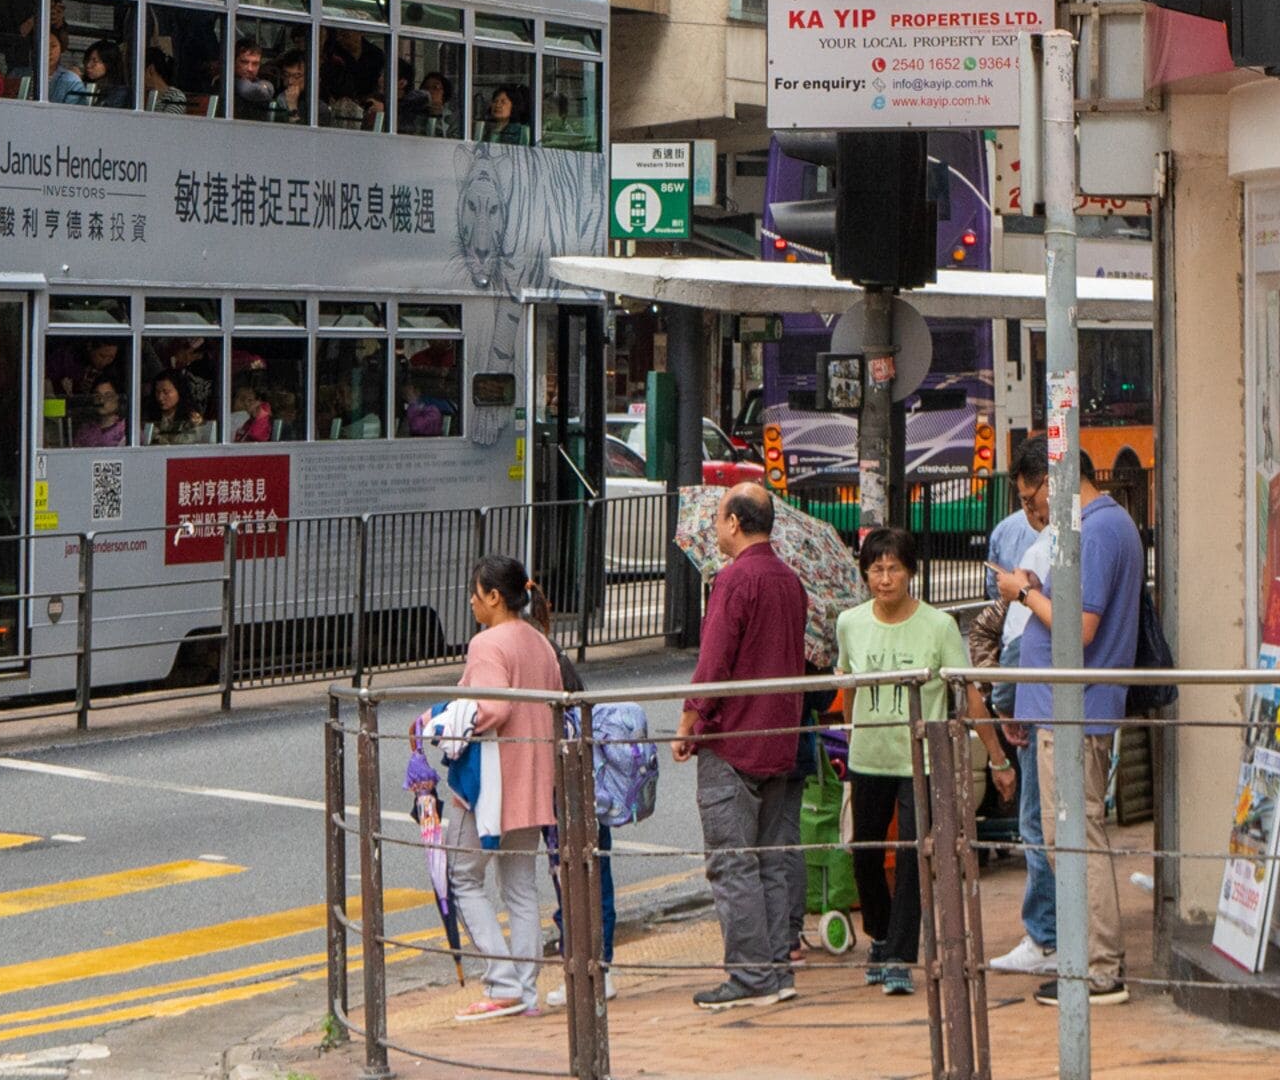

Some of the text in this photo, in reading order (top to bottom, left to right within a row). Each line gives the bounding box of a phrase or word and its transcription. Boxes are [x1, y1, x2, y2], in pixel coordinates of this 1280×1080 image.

[788, 9, 1043, 29] KA YIP PROPERTIES LTD.
[819, 35, 1019, 49] YOUR LOCAL PROPERTY EXP
[892, 58, 923, 71] 2540
[929, 58, 960, 70] 1652
[978, 57, 1011, 70] 9364
[774, 77, 866, 92] For enquiry:
[892, 77, 994, 92] info@kayip.com.hk
[892, 96, 991, 110] www.kayip.com.hk
[0, 141, 148, 183] Janus Henderson
[42, 185, 106, 200] INVESTORS
